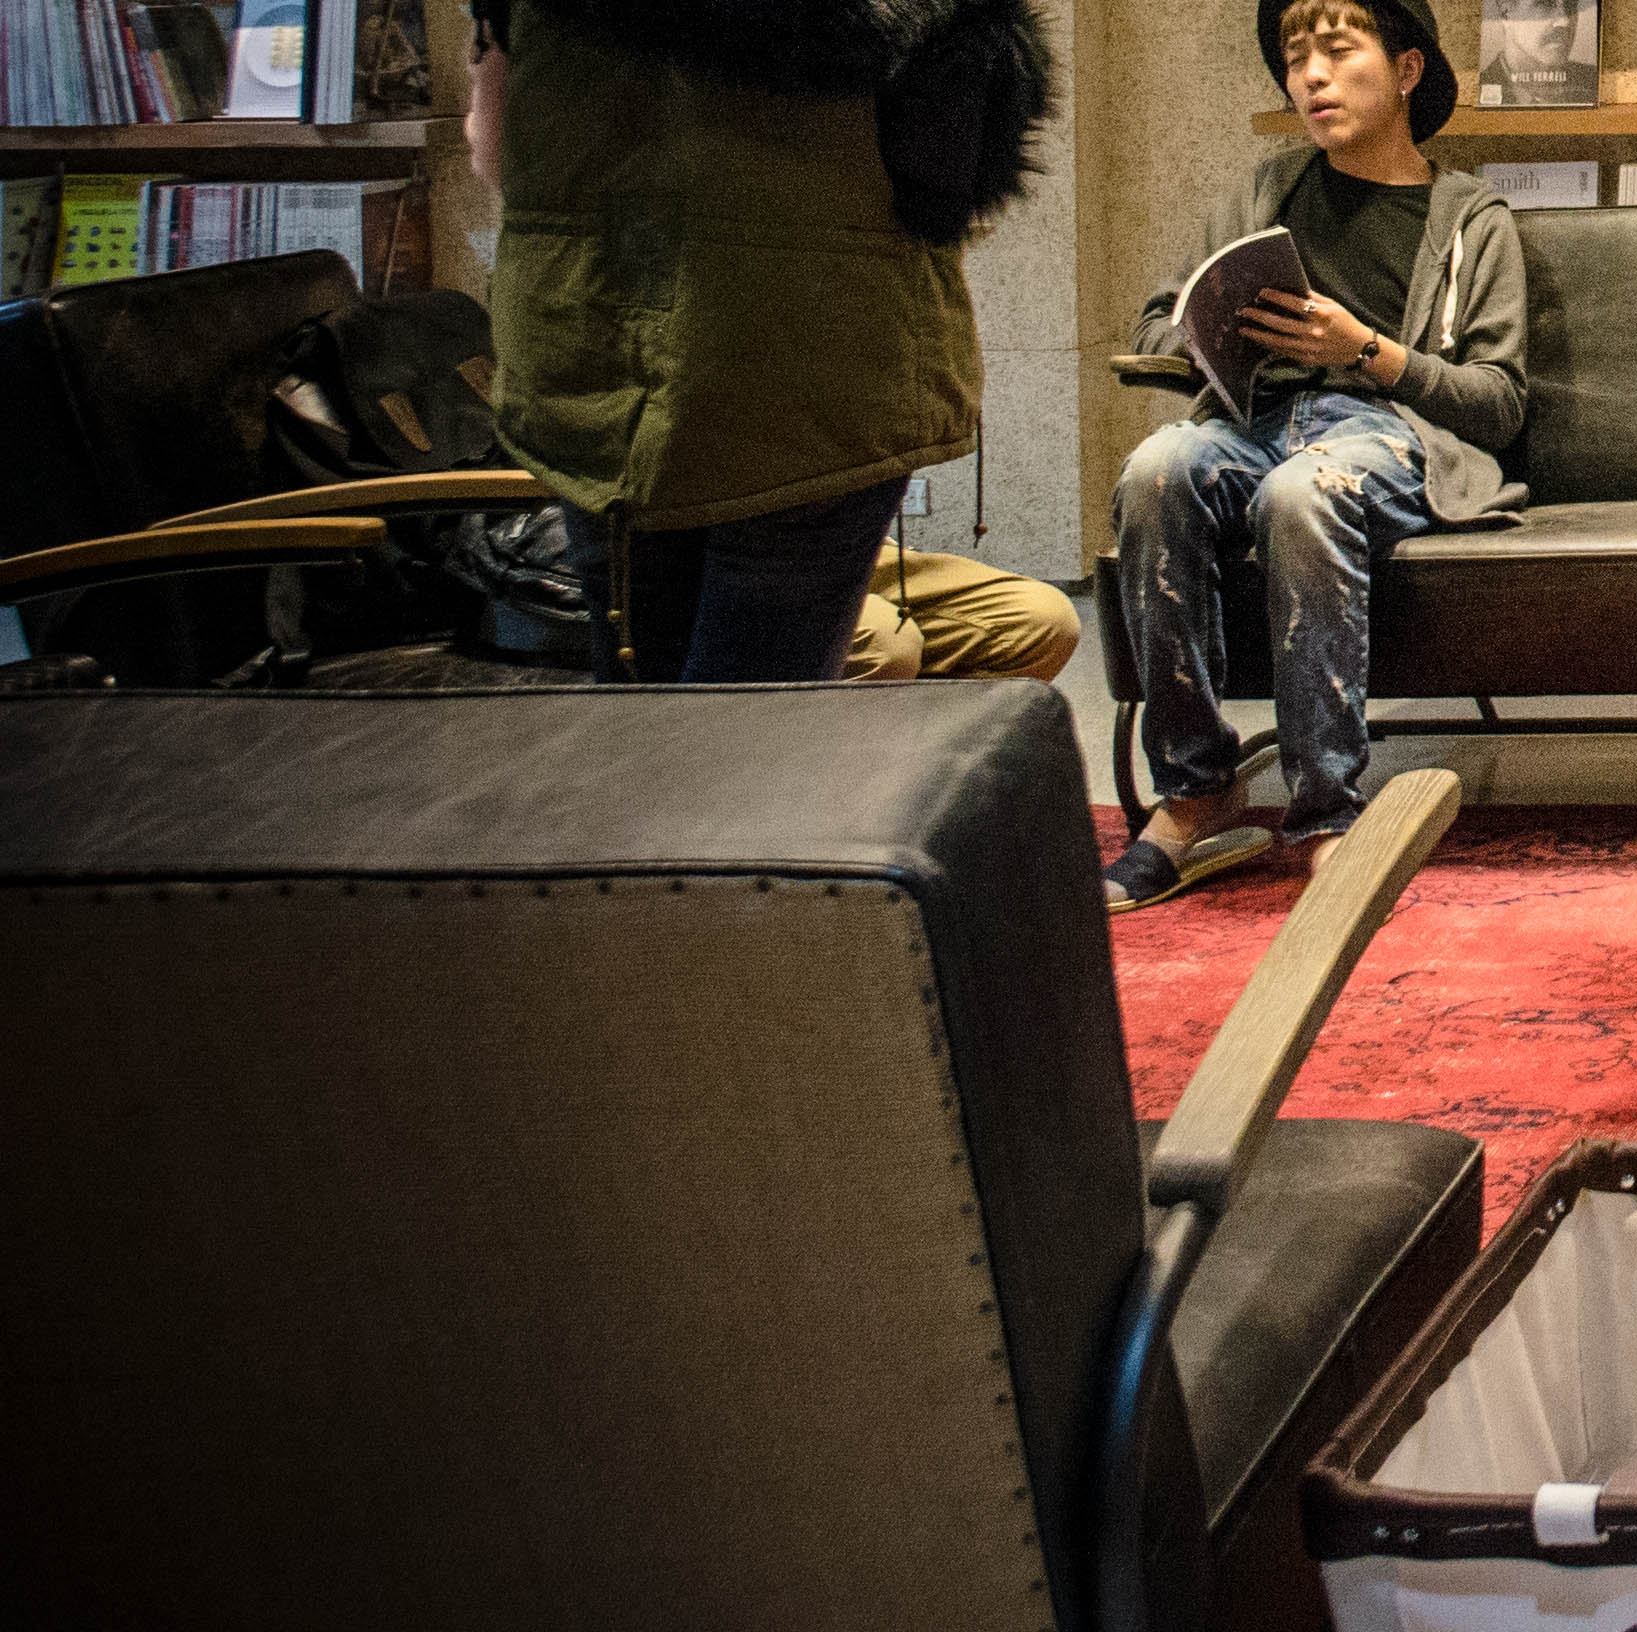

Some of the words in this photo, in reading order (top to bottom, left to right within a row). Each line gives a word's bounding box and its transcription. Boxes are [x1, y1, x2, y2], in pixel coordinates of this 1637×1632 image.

[1511, 71, 1531, 82] WILL
[1533, 70, 1567, 82] FERRELL
[1492, 171, 1541, 191] smith
